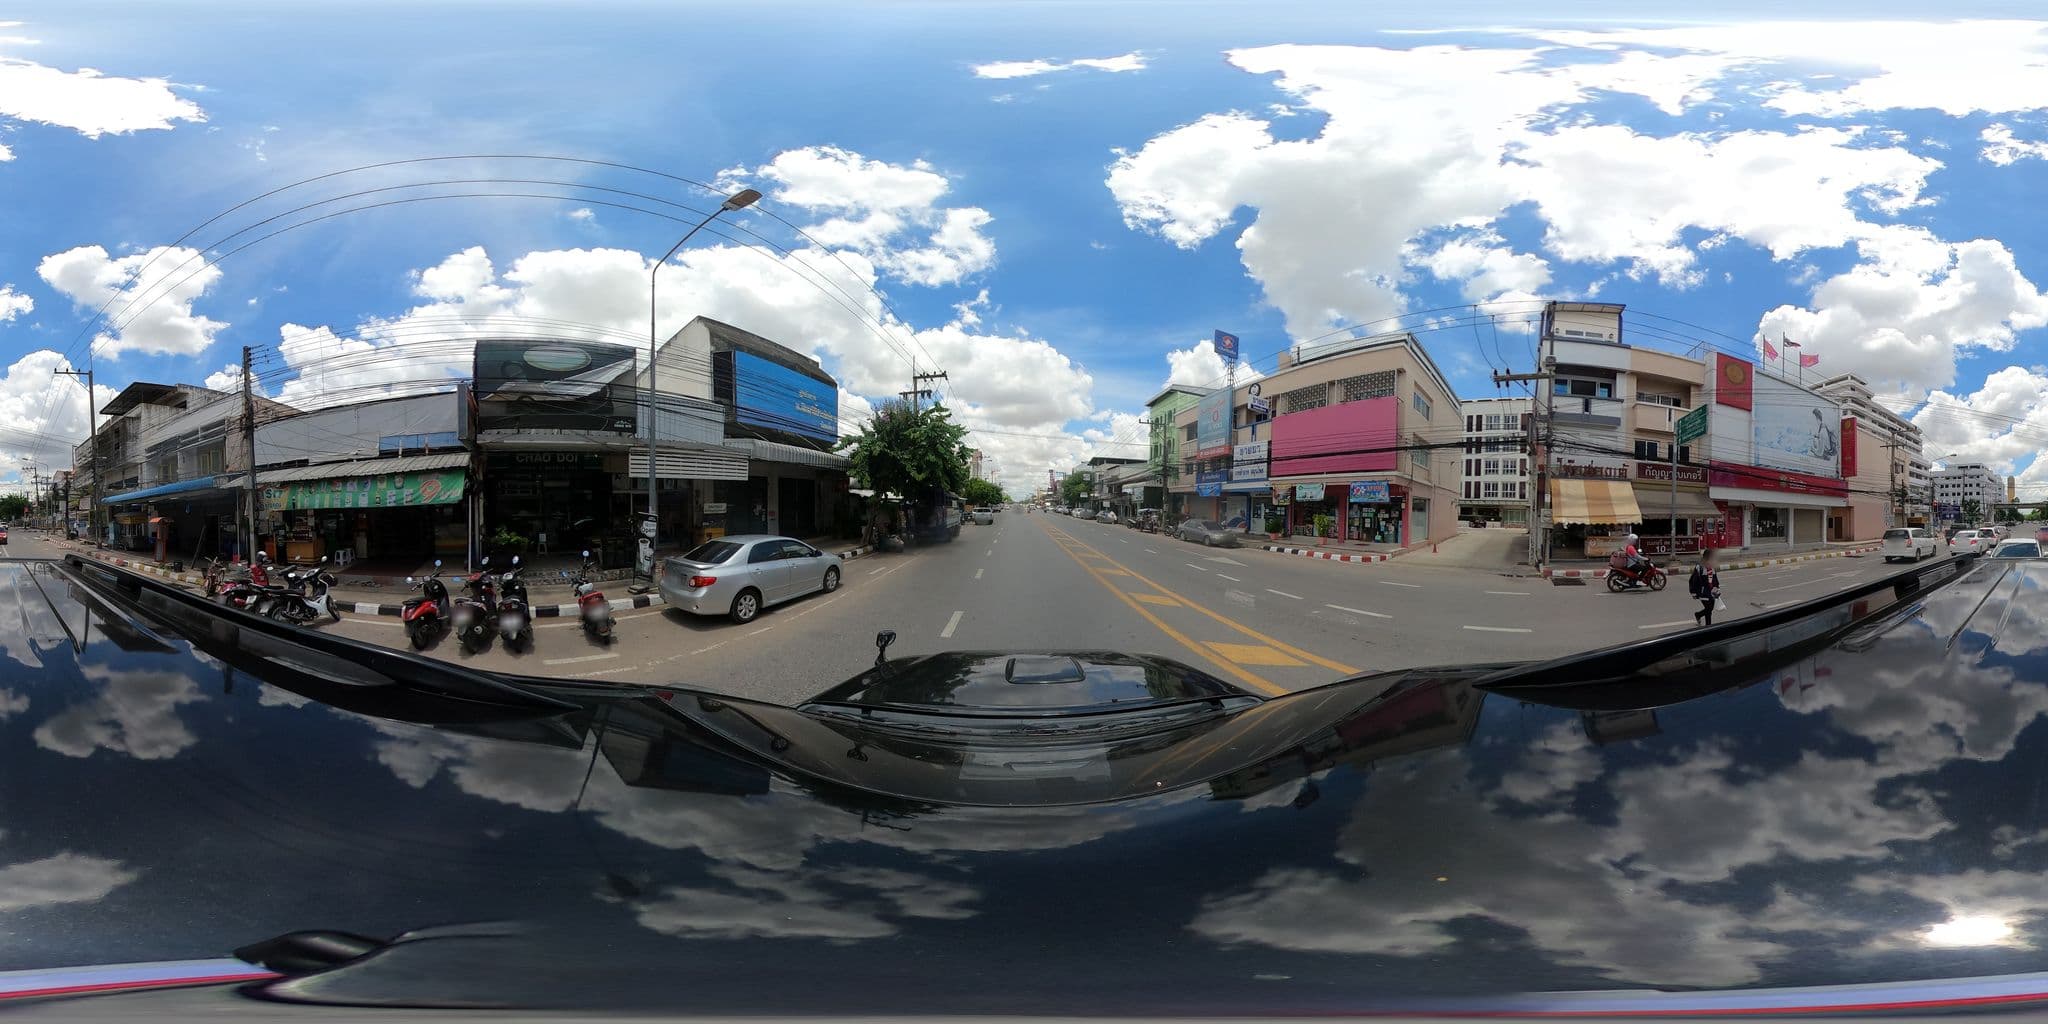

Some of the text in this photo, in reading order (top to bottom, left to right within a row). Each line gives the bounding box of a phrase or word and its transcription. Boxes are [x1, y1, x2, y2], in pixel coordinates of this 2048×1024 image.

[516, 453, 578, 463] CHAO DOI
[1645, 465, 1702, 480] กัญญาบเกอรี่
[1656, 545, 1666, 553] 10
